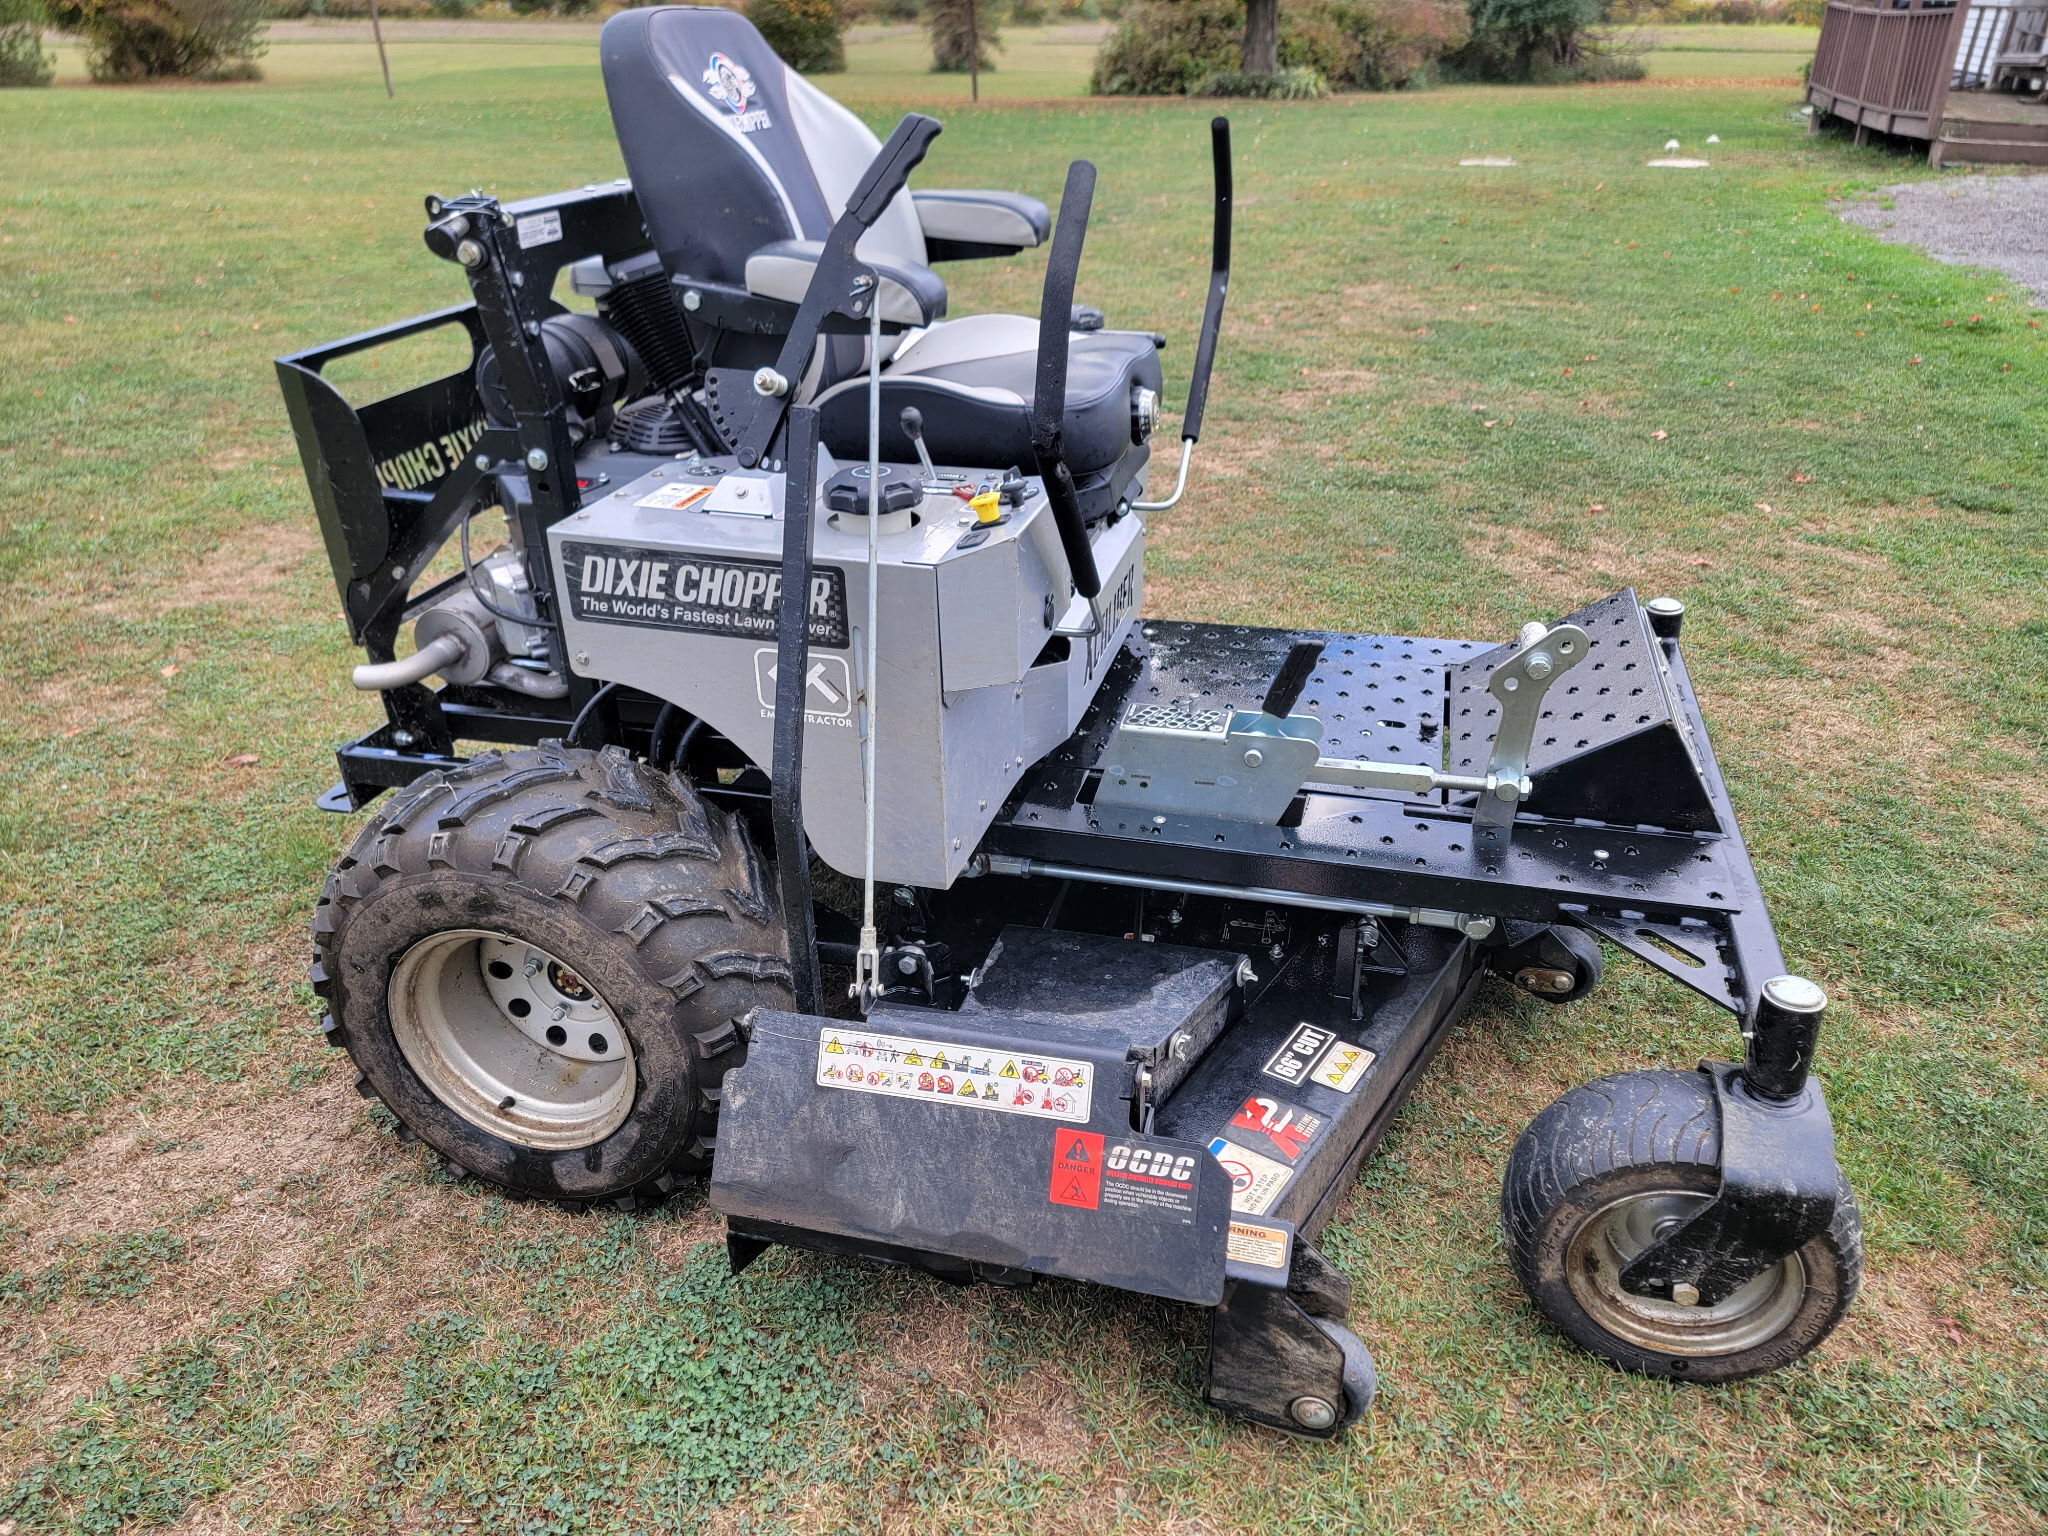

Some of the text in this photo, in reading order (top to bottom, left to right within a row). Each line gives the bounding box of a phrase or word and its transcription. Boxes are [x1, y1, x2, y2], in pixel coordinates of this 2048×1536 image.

[580, 555, 831, 617] DIXIE CHOPPR
[580, 596, 609, 613] The
[612, 600, 670, 619] World's
[672, 606, 730, 626] Fastest
[733, 614, 776, 631] Lawn
[1292, 1028, 1326, 1056] CUT
[1302, 1117, 1321, 1138] SYSTEM
[1057, 1162, 1096, 1175] DANGER
[1107, 1145, 1195, 1181] OCDC
[1243, 1191, 1256, 1204] NOT
[1247, 1202, 1257, 1212] NO
[1229, 1226, 1267, 1239] RNING
